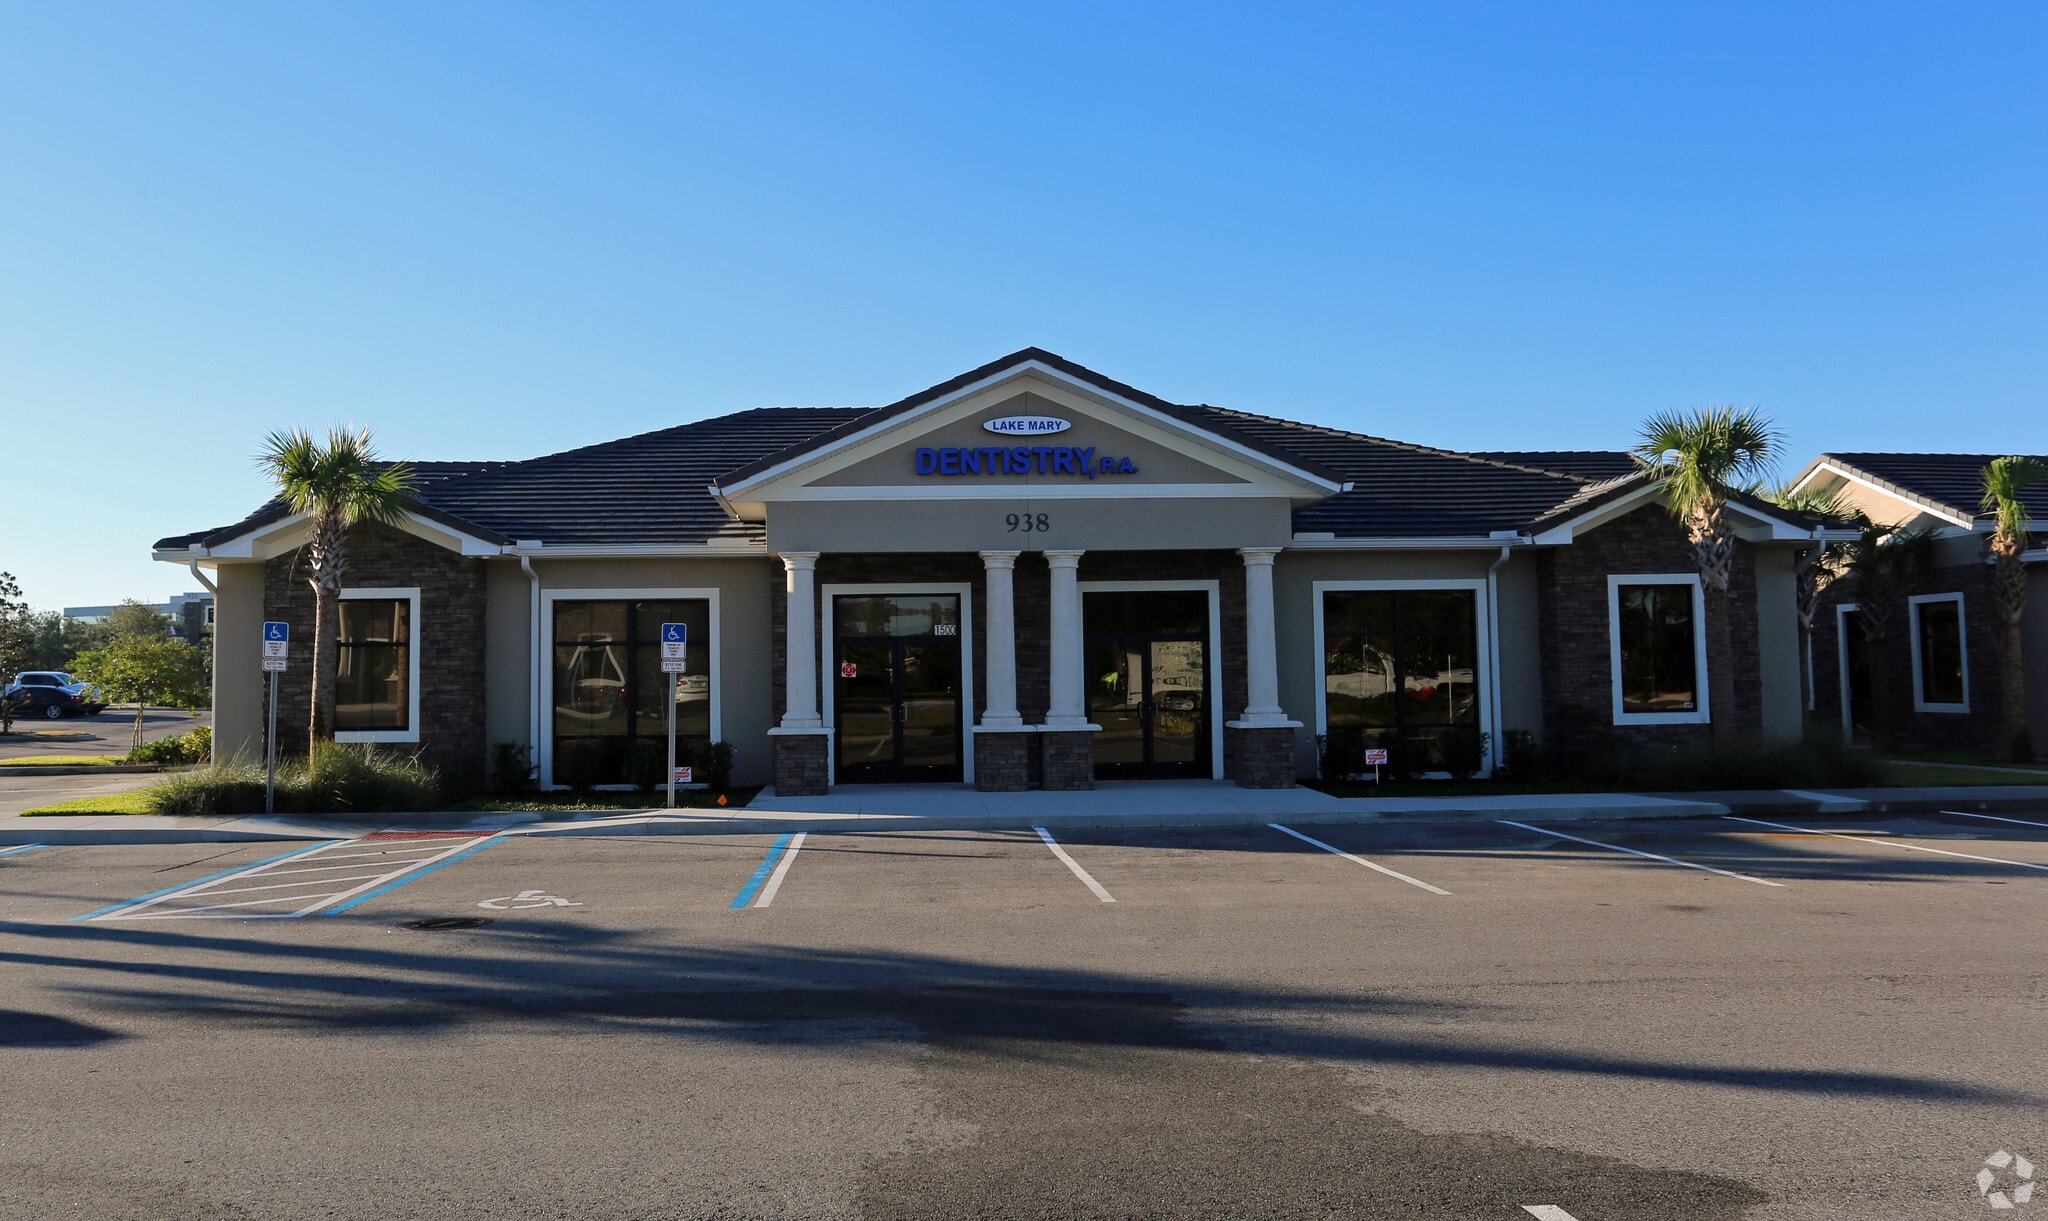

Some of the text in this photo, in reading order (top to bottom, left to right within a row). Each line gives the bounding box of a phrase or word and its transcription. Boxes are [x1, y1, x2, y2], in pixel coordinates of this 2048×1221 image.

[992, 420, 1062, 431] LAKE MARY
[916, 446, 1139, 479] DENTISTRY, P.A.
[1005, 513, 1050, 532] 938
[935, 625, 956, 635] 1500
